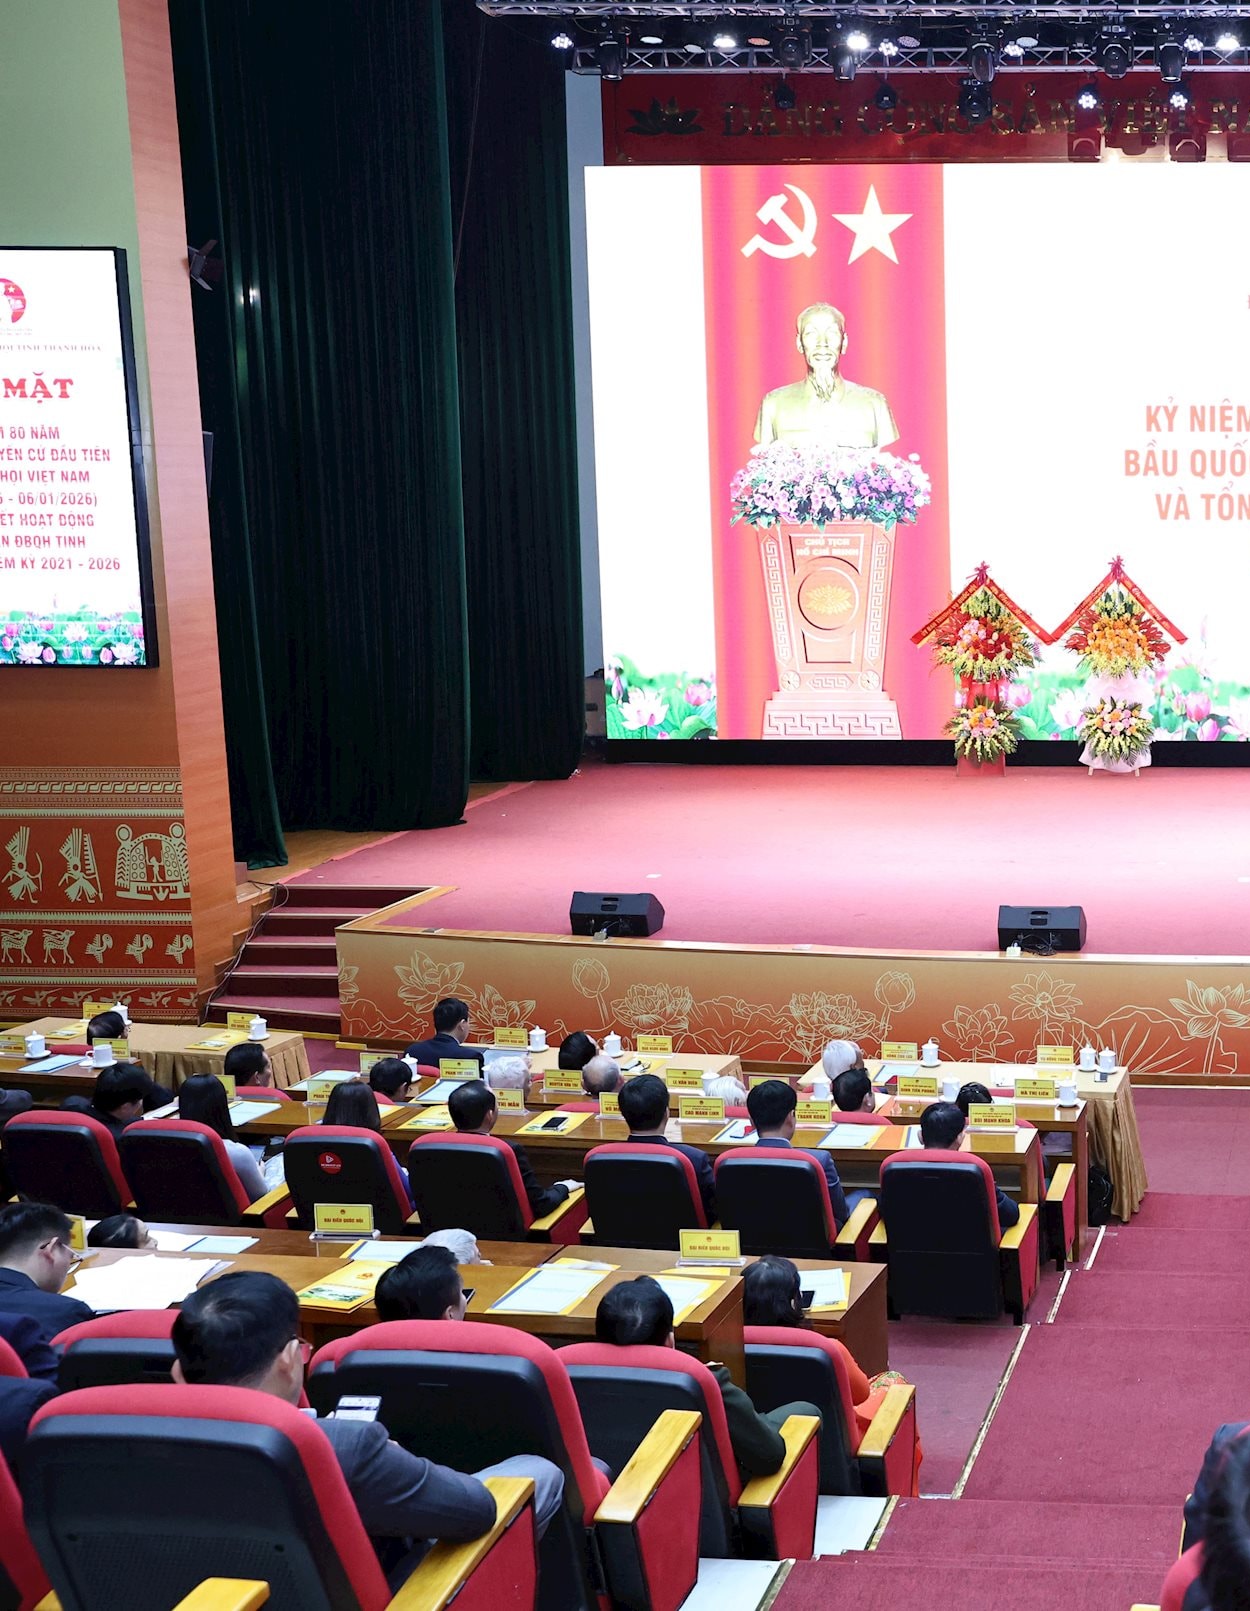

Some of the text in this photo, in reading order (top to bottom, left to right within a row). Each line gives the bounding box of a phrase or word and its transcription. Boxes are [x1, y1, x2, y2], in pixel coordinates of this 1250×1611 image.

[2, 371, 74, 404] MẶT
[1146, 396, 1178, 433] KỶ
[10, 426, 26, 440] 80
[30, 424, 60, 440] NĂM
[1124, 439, 1178, 477] BẦU
[60, 470, 91, 483] NAM
[18, 491, 98, 507] 06/01/2026)
[1155, 487, 1190, 520] VÀ
[14, 535, 51, 549] ĐBQH
[41, 556, 73, 570] 2021
[88, 557, 121, 571] 2026
